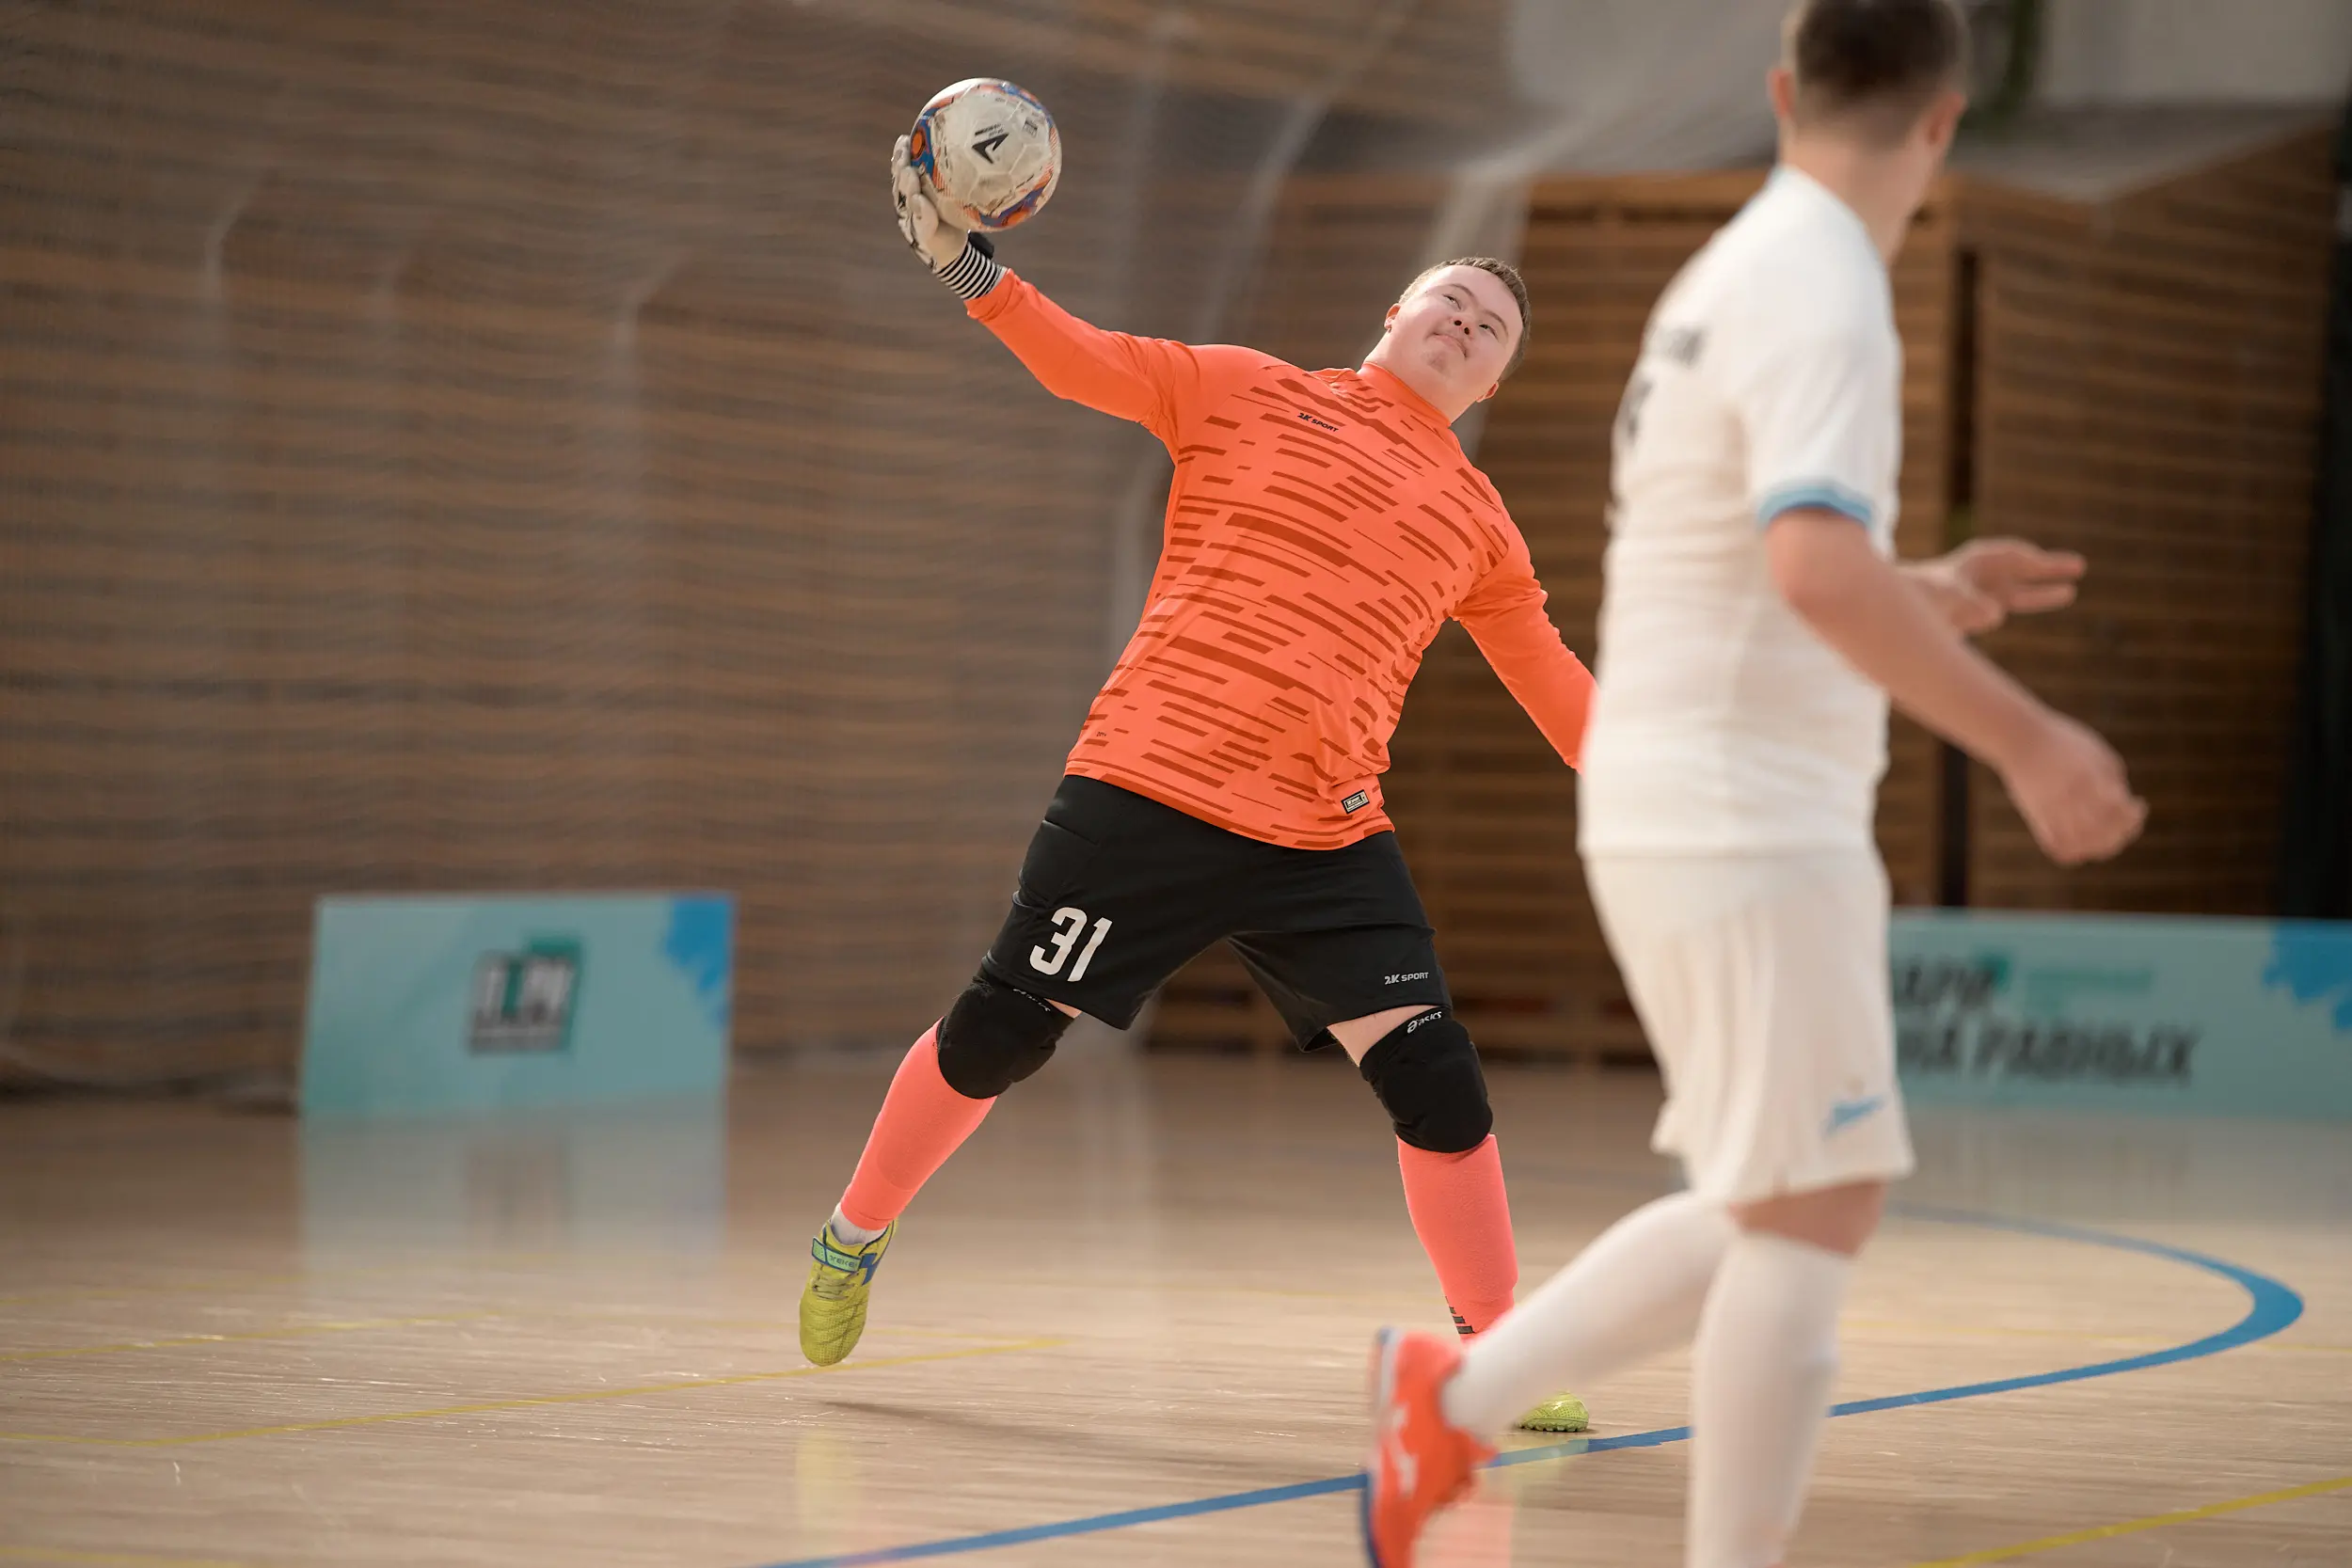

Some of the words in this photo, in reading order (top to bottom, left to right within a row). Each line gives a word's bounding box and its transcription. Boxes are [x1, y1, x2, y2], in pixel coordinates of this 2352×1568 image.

[1296, 412, 1313, 421] 2K
[1311, 419, 1340, 433] SPORT
[1029, 907, 1113, 982] 31
[1384, 974, 1400, 985] 2K
[1401, 972, 1429, 982] SPORT
